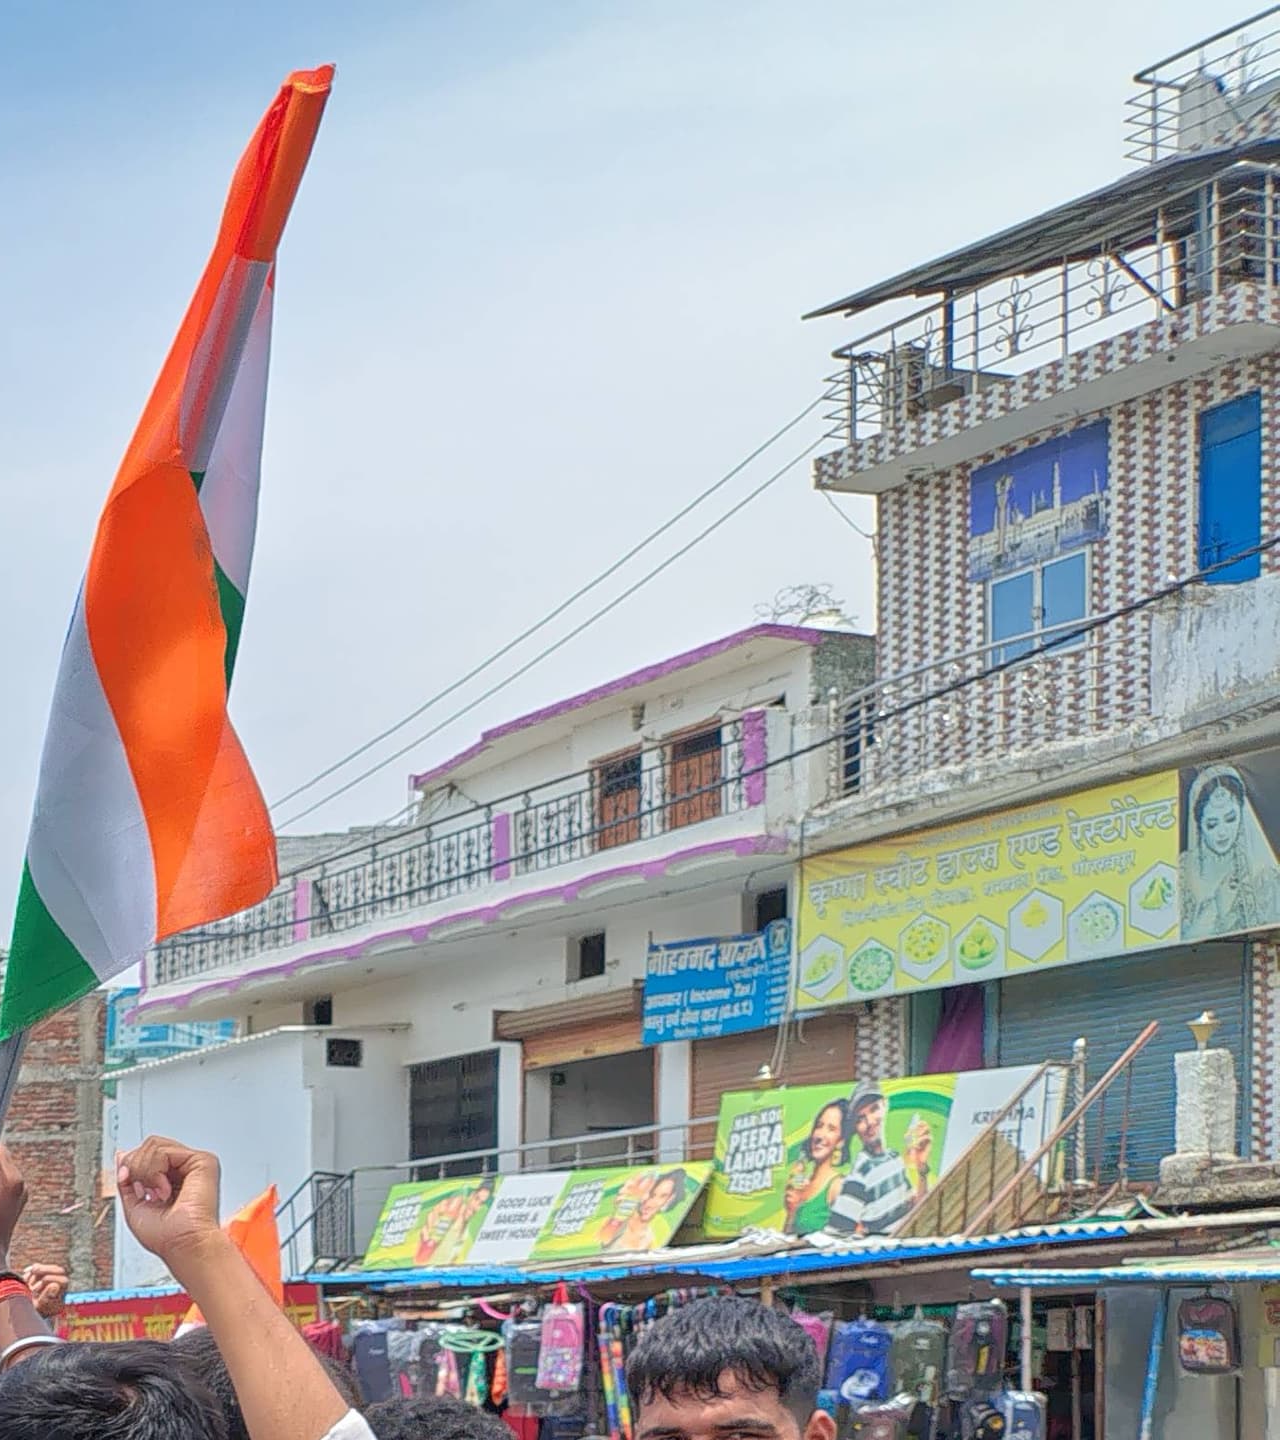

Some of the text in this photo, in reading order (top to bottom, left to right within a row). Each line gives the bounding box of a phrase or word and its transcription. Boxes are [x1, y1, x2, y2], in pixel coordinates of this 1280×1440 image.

[936, 841, 1000, 885] हाउस
[1007, 824, 1062, 869] एण्ड
[730, 1124, 783, 1152] PEERA
[724, 1145, 784, 1173] LAHORI
[728, 1168, 773, 1193] ZEERA
[496, 1195, 554, 1210] GOOD LUCK
[479, 1228, 541, 1241] SWEET HOUSE
